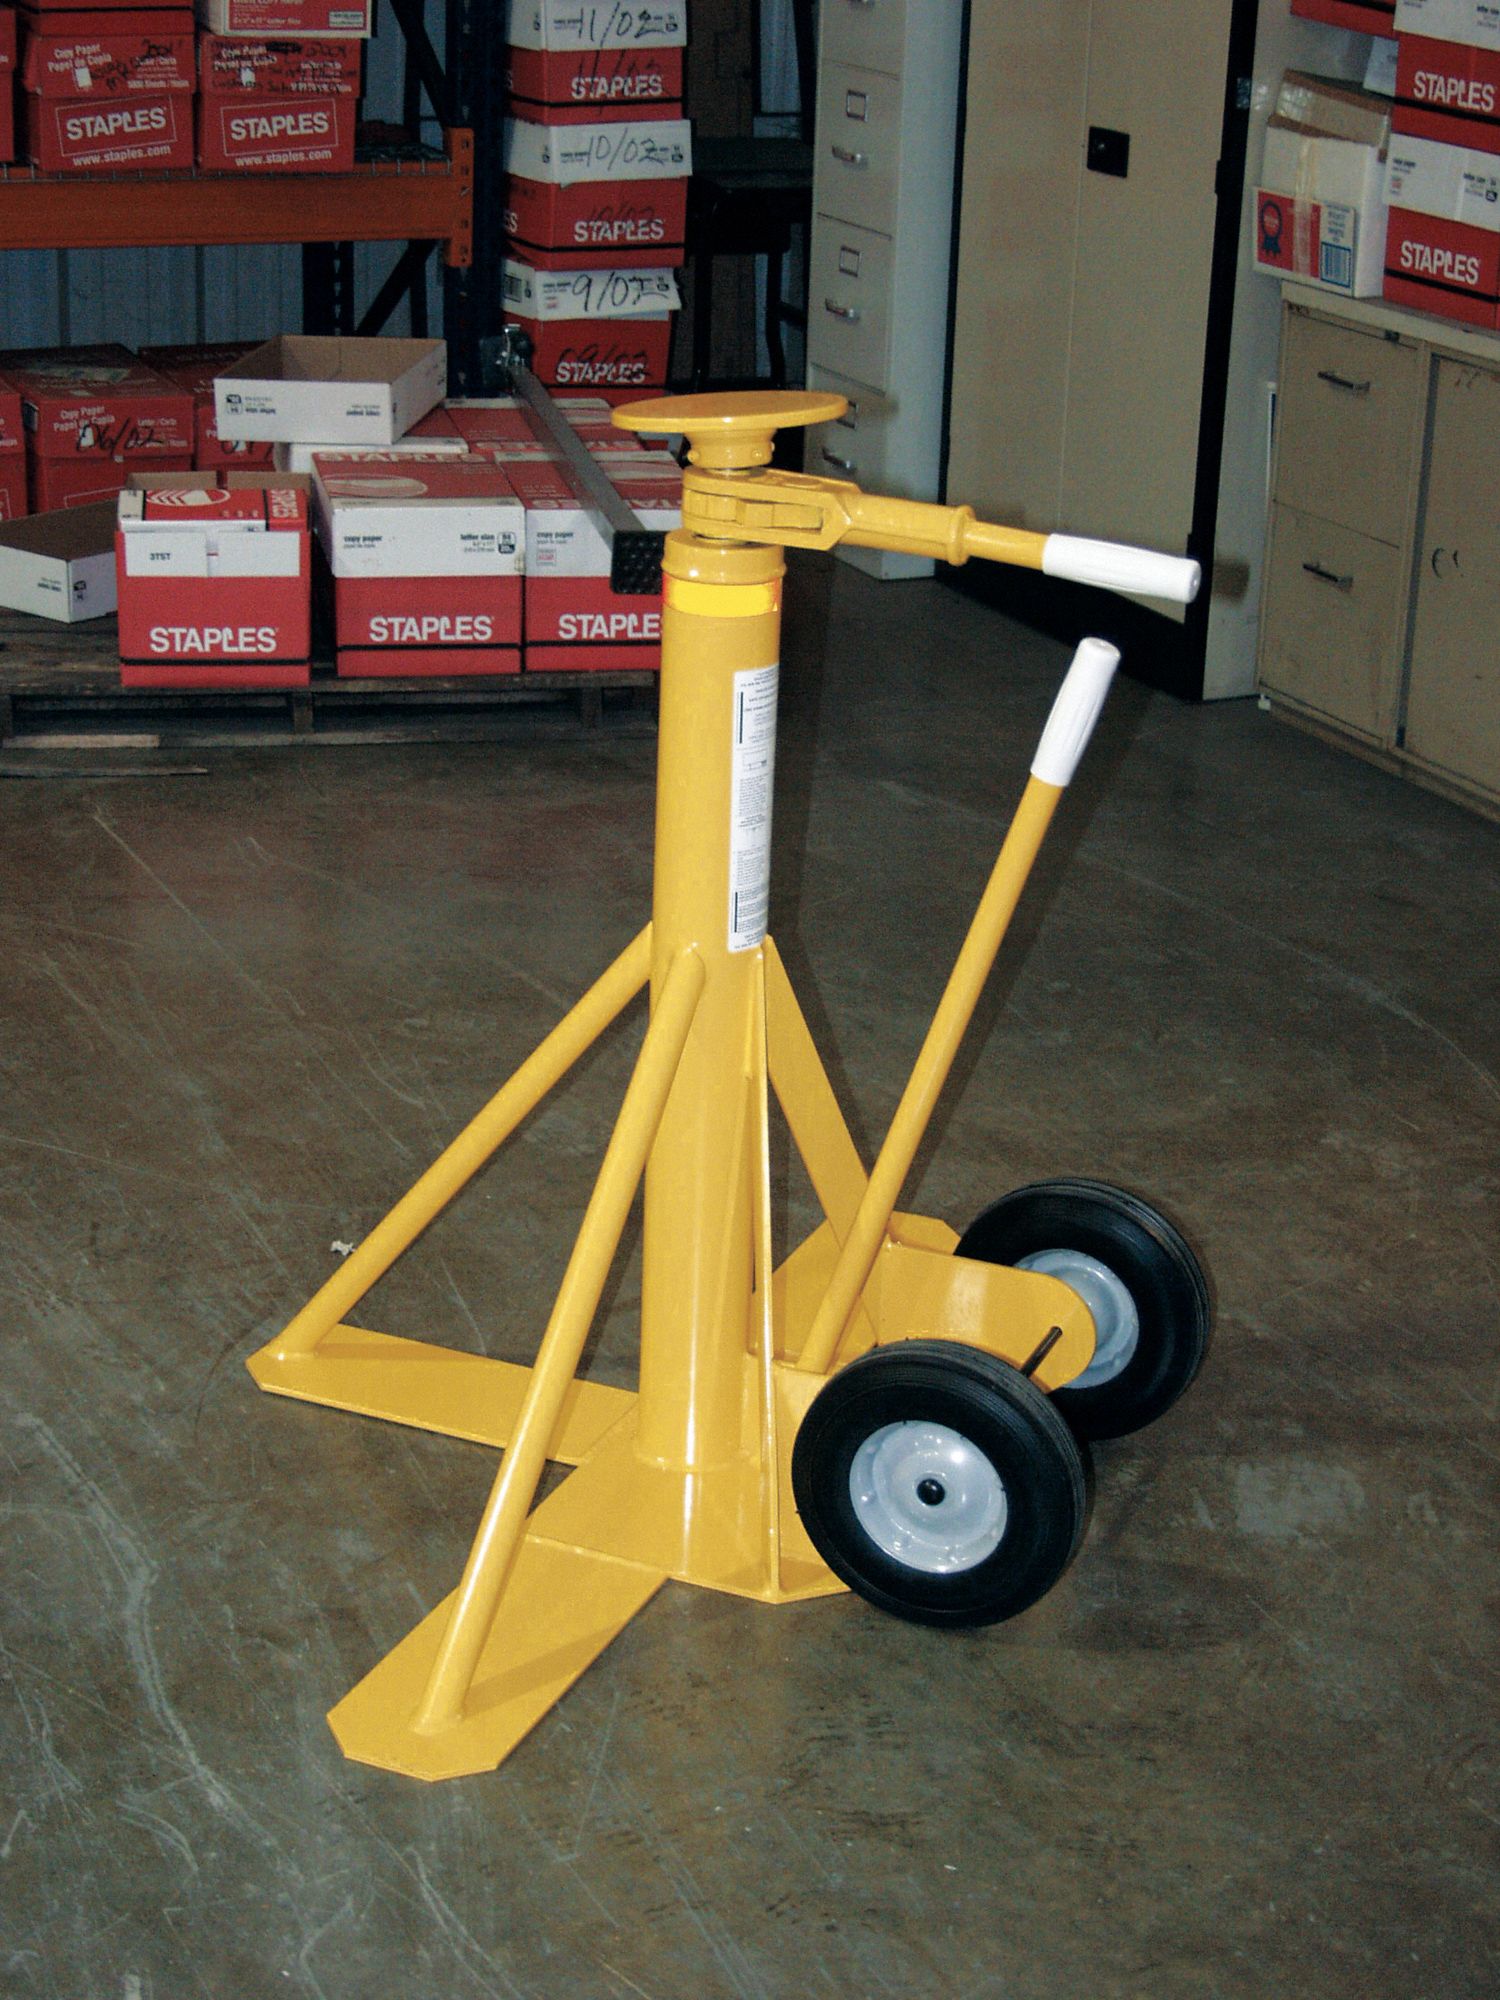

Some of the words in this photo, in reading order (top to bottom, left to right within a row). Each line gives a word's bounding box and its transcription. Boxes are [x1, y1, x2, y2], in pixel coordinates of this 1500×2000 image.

[571, 75, 662, 99] STAPLES
[1413, 71, 1496, 112] STAPLES
[66, 107, 167, 140] STAPLES
[230, 112, 330, 141] STAPLES
[72, 145, 172, 168] www.staples.com
[235, 150, 332, 167] www.staples.com
[574, 219, 664, 242] STAPLES
[1400, 240, 1480, 285] STAPLES
[556, 361, 646, 384] STAPLES
[362, 534, 382, 543] paper
[150, 627, 277, 653] STAPLES
[369, 616, 493, 642] STAPLES
[558, 614, 662, 640] STAPLE
